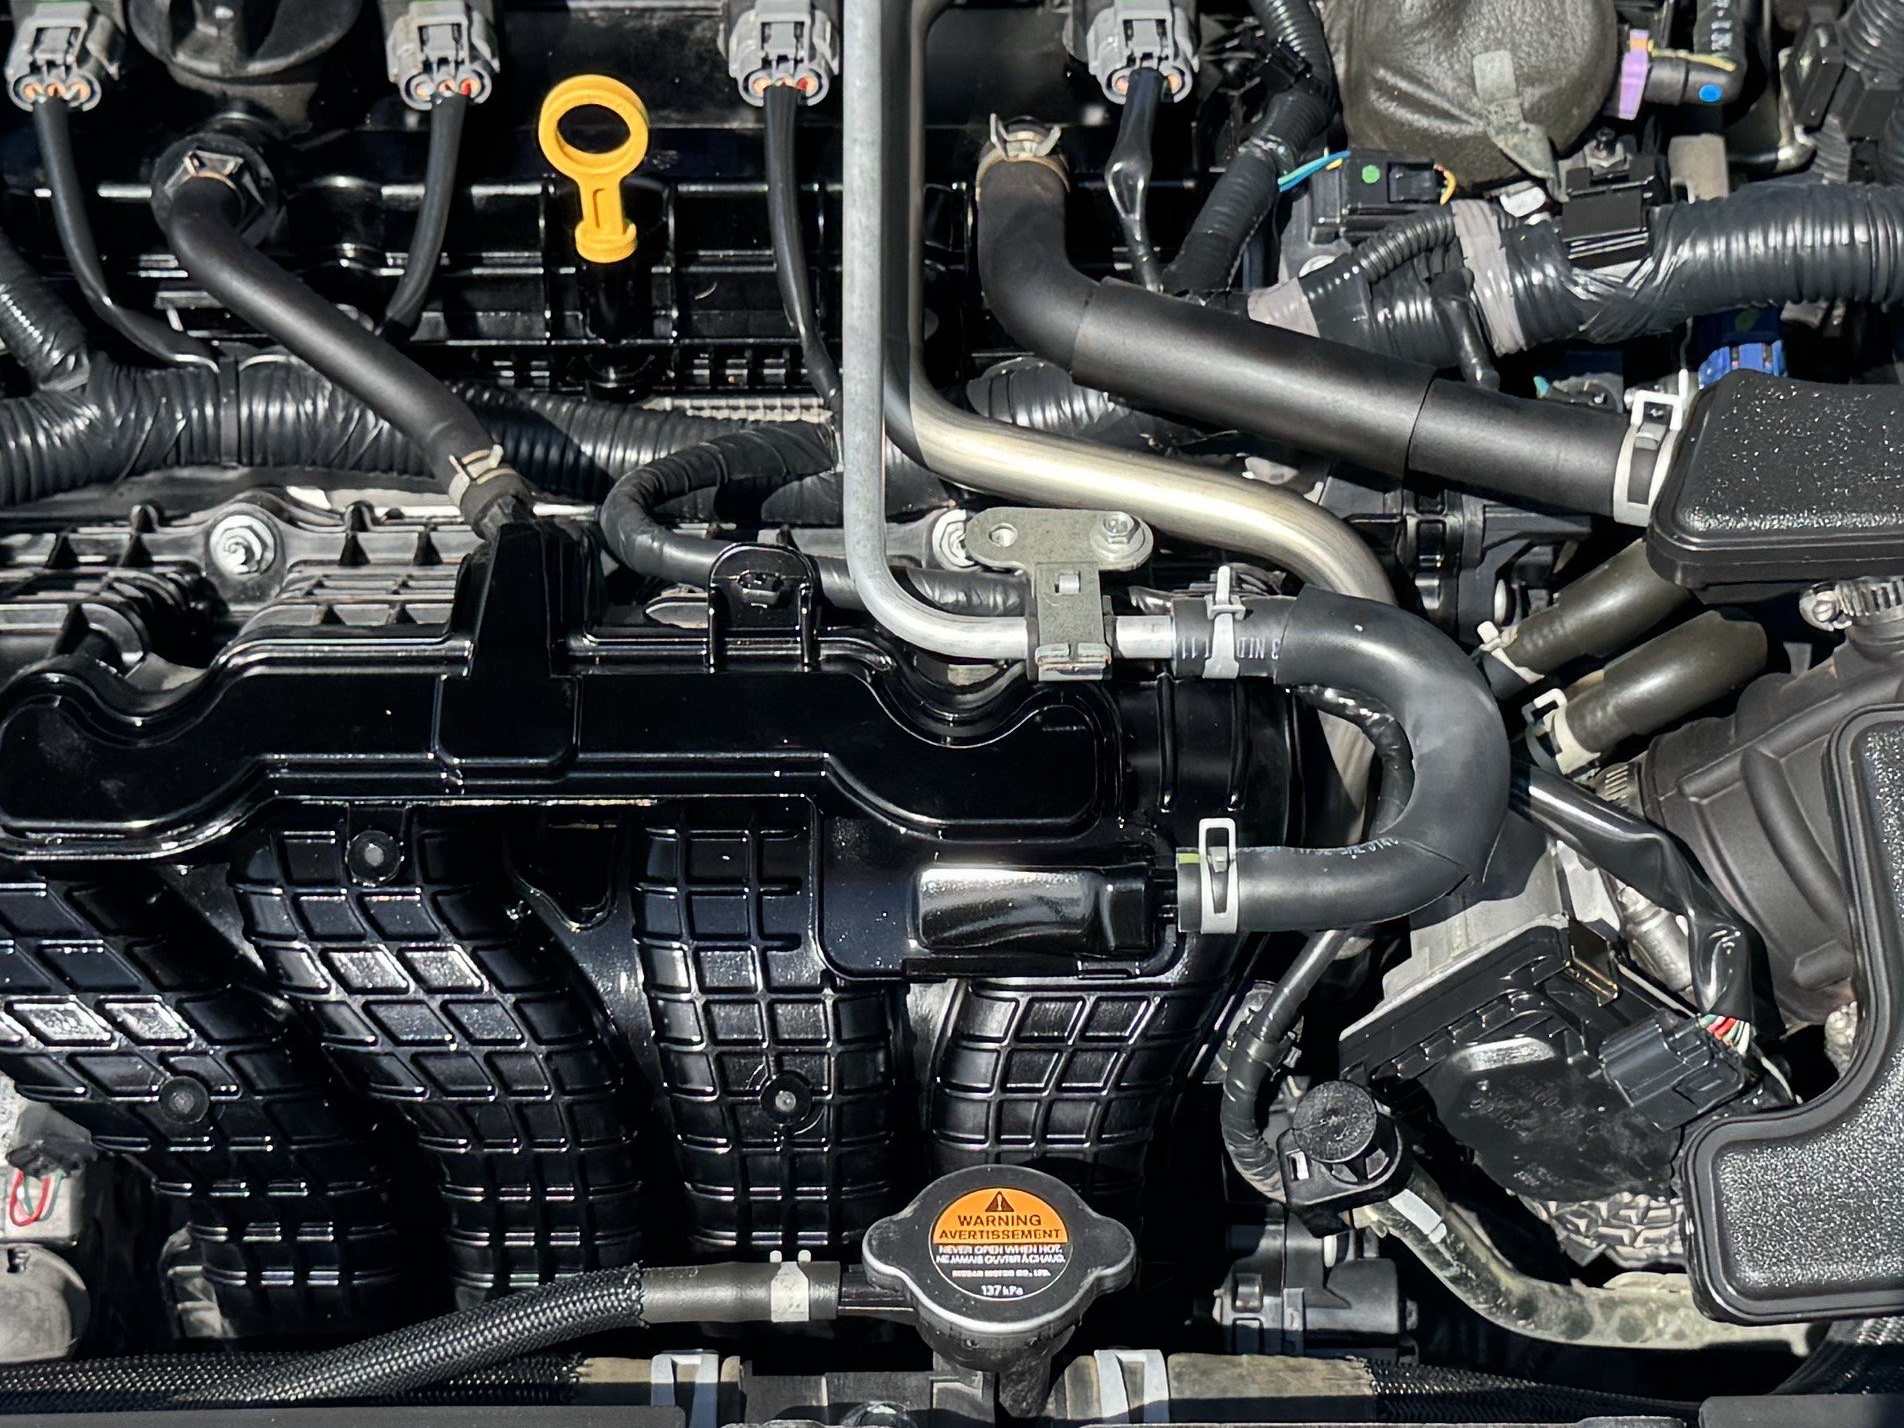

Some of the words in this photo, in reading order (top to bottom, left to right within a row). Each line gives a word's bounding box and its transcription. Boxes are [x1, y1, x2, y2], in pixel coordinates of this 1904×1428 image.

[958, 1214, 1042, 1227] WARNING
[939, 1229, 1061, 1240] AVERTISSEMENT
[974, 1245, 1003, 1254] OPEN
[1005, 1245, 1036, 1254] WHEN
[981, 1285, 1002, 1296] 137
